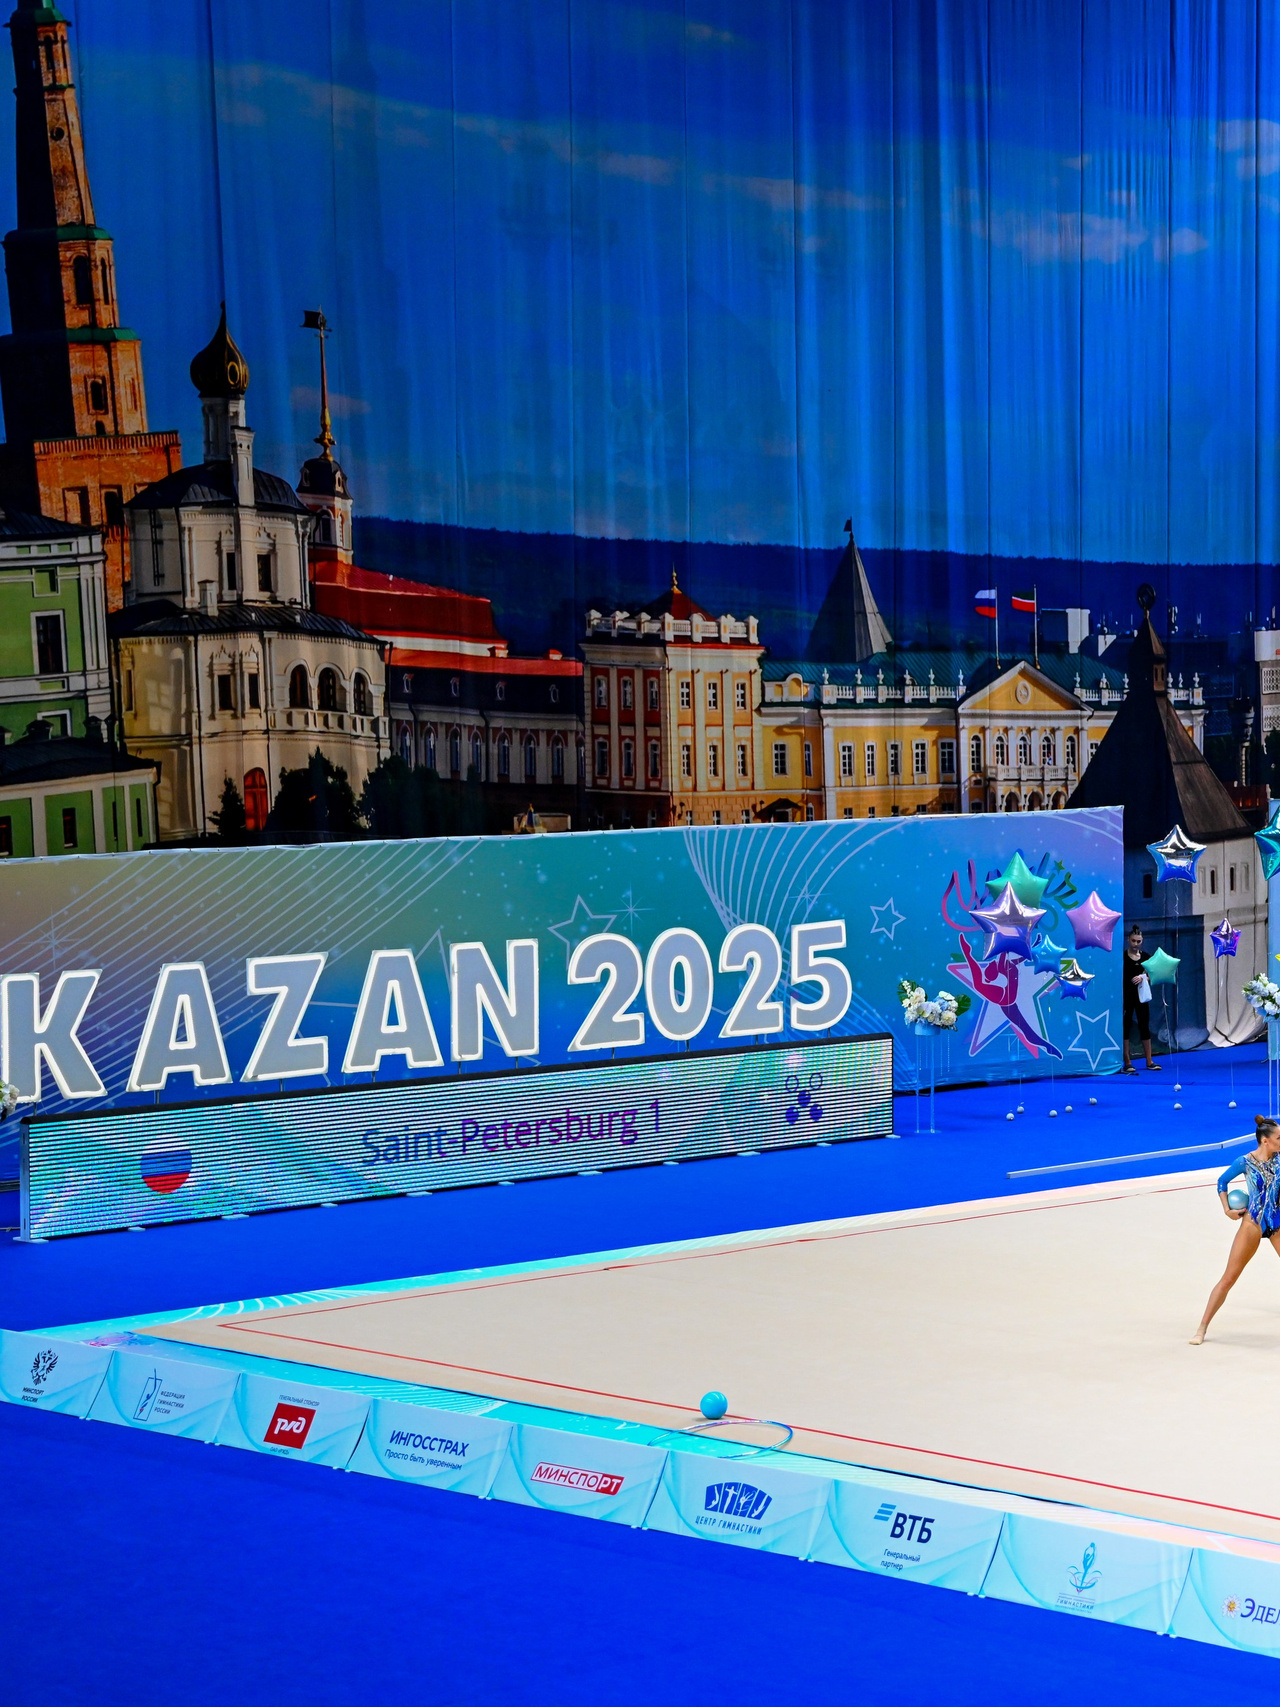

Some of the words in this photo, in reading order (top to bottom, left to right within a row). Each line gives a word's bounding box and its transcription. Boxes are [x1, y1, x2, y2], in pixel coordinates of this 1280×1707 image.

[0, 938, 540, 1103] KAZAN
[567, 919, 853, 1052] 2025
[361, 1108, 638, 1166] Saint-Petersburg
[651, 1099, 660, 1133] 1
[156, 1399, 185, 1409] ГИМНАСТИКИ
[160, 1390, 186, 1400] ФЕДЕРАЦИЯ
[153, 1406, 171, 1415] РОССИИ
[389, 1429, 470, 1457] ИНГОССТРАХ
[384, 1449, 409, 1462] Просто
[409, 1452, 426, 1464] быть
[425, 1456, 463, 1471] уверенным
[534, 1464, 622, 1493] МИНСПОРТ
[695, 1514, 716, 1527] ЦЕНТР
[717, 1518, 763, 1535] ГИМНАСТИКИ
[889, 1511, 936, 1544] ВТБ
[883, 1548, 921, 1562] Генеральный
[880, 1560, 904, 1572] партнер
